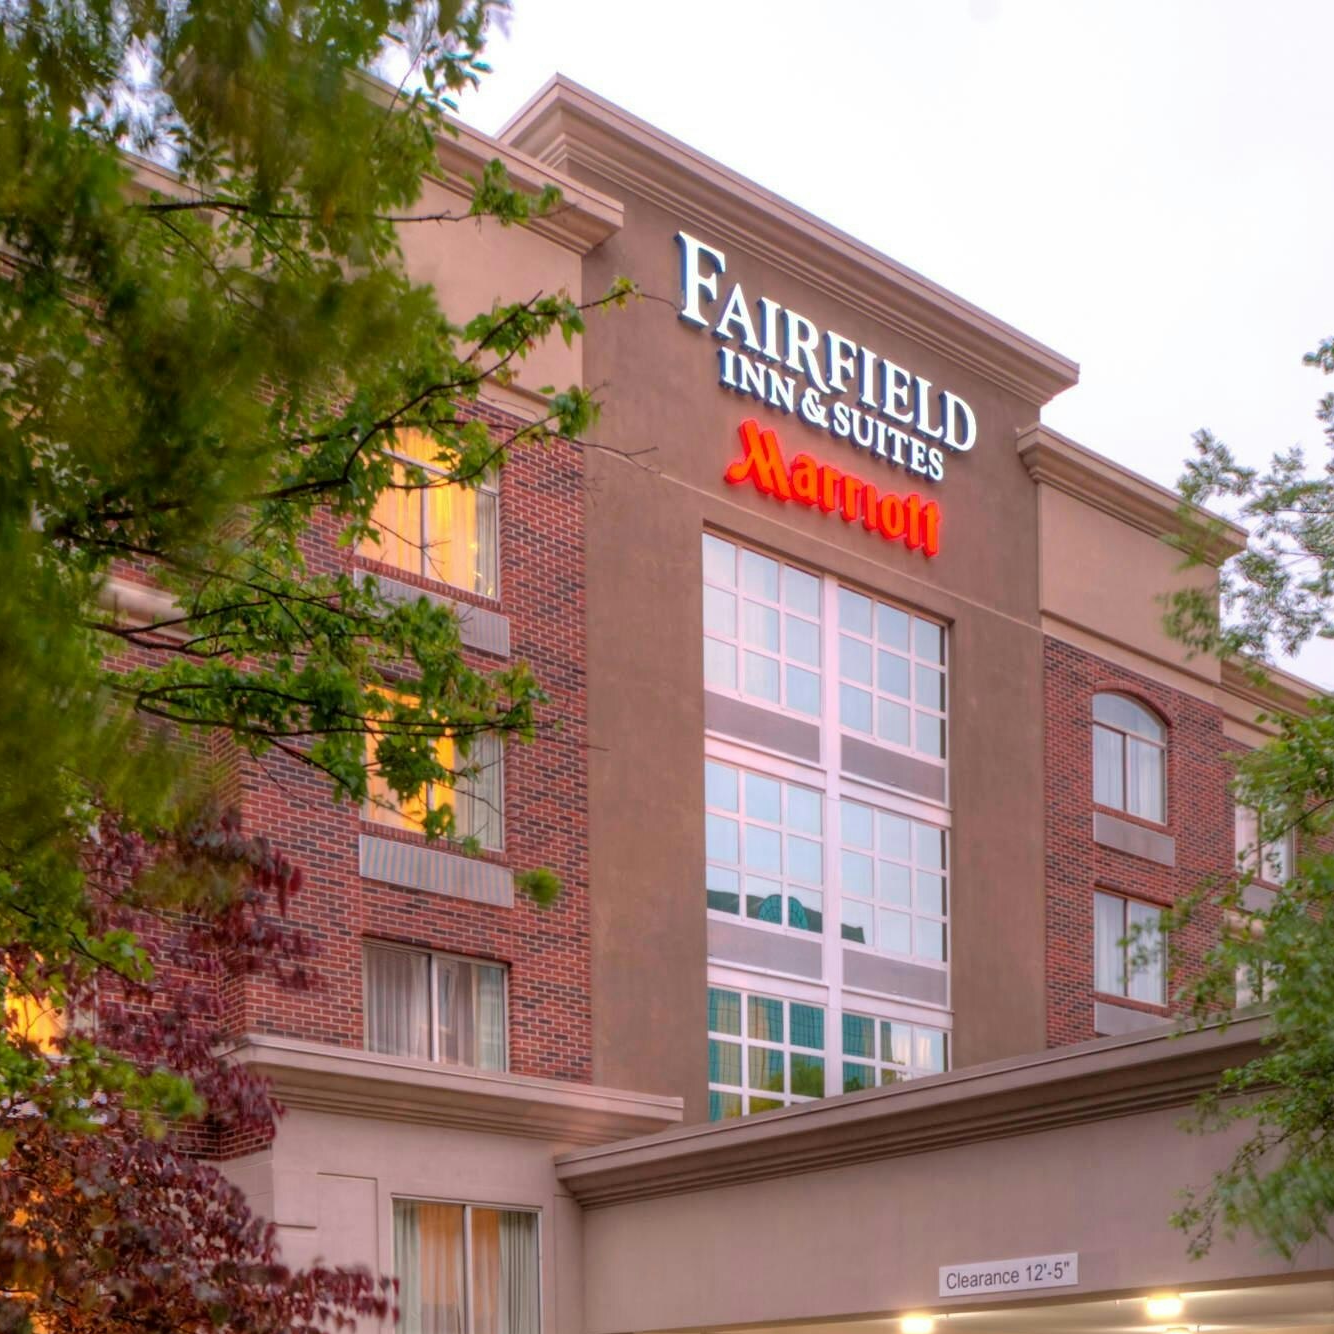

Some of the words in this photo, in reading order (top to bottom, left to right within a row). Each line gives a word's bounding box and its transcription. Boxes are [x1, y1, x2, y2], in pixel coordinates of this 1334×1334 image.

[676, 230, 977, 453] FAIRFIELD
[720, 346, 797, 414] INN
[832, 401, 944, 482] SUITES
[724, 418, 940, 557] Marriott
[946, 1269, 1020, 1290] Clearance
